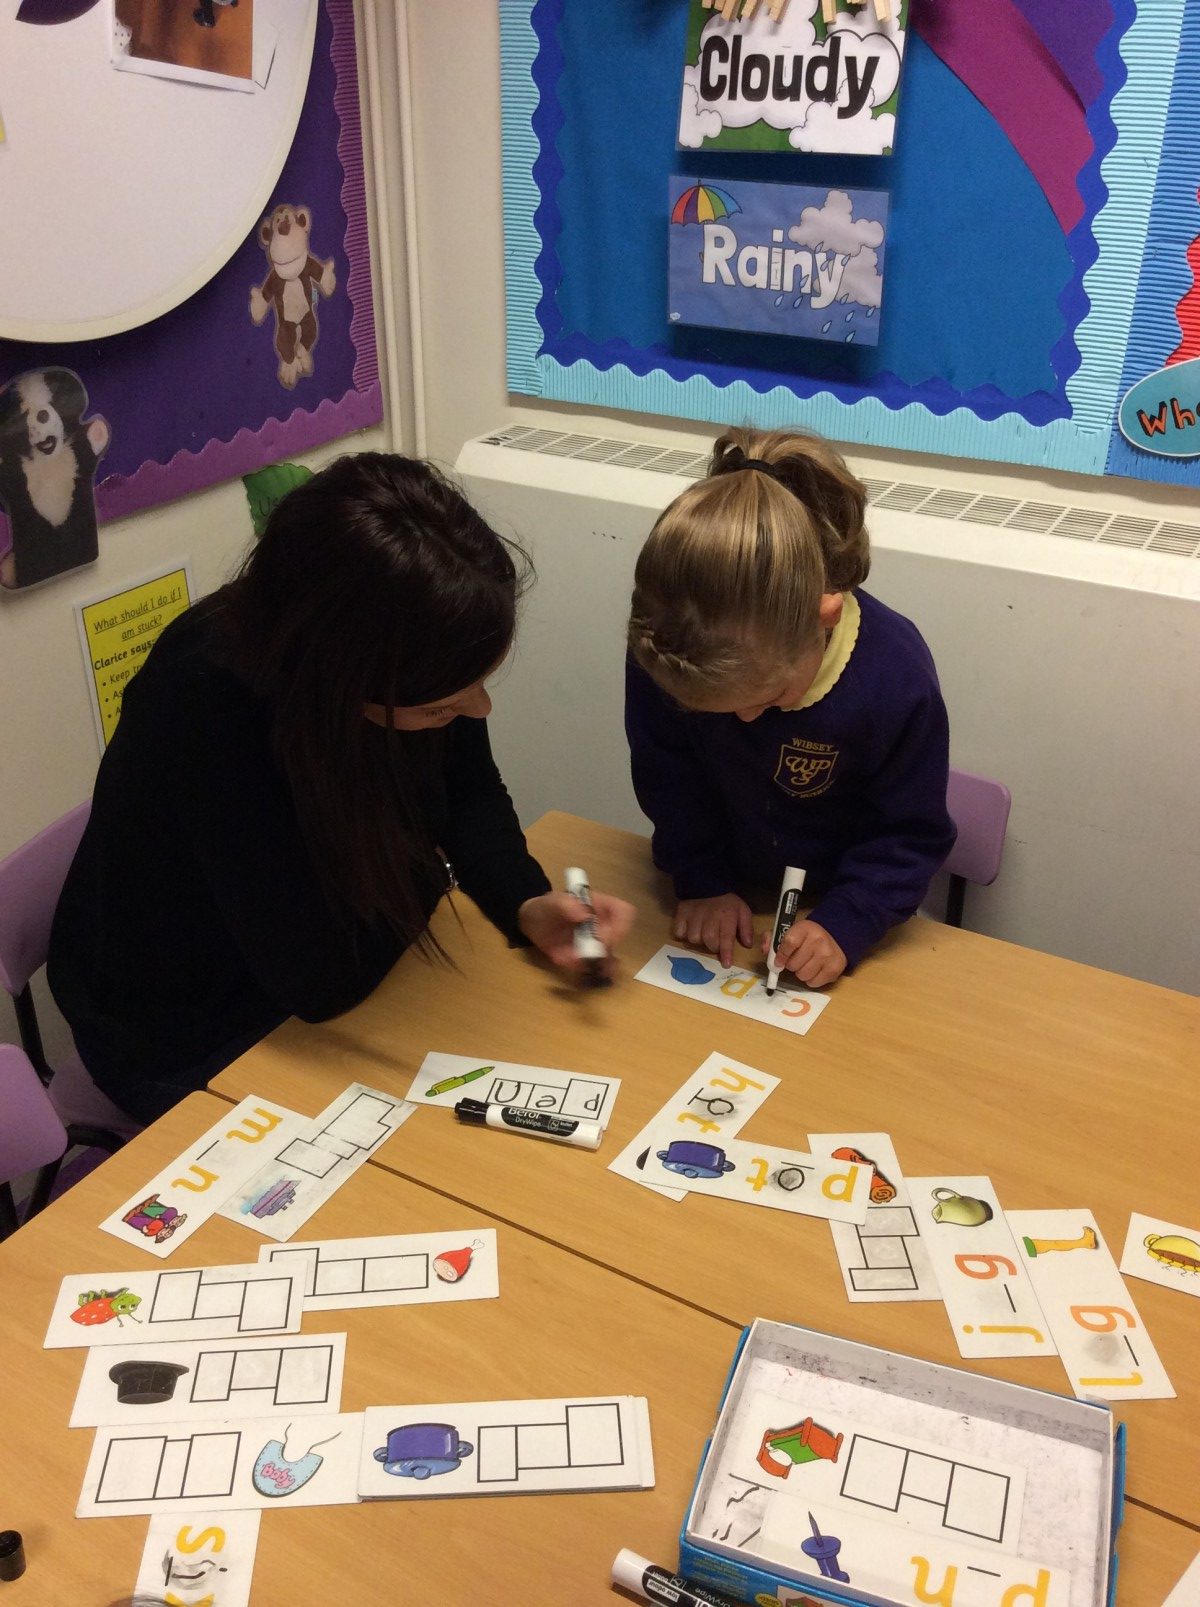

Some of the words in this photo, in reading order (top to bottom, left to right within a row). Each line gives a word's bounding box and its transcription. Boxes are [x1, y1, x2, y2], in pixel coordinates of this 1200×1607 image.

[700, 35, 880, 119] Cloudy
[702, 224, 846, 309] Rainy
[1136, 397, 1200, 437] Wh
[93, 615, 119, 632] What
[120, 601, 149, 622] should
[157, 594, 168, 605] do
[121, 629, 135, 640] am
[137, 614, 163, 632] stuck?
[94, 649, 128, 671] Clarice
[109, 669, 130, 685] Keep
[792, 737, 834, 753] WIBSEY
[648, 1579, 668, 1596] odour
[665, 1588, 679, 1602] low
